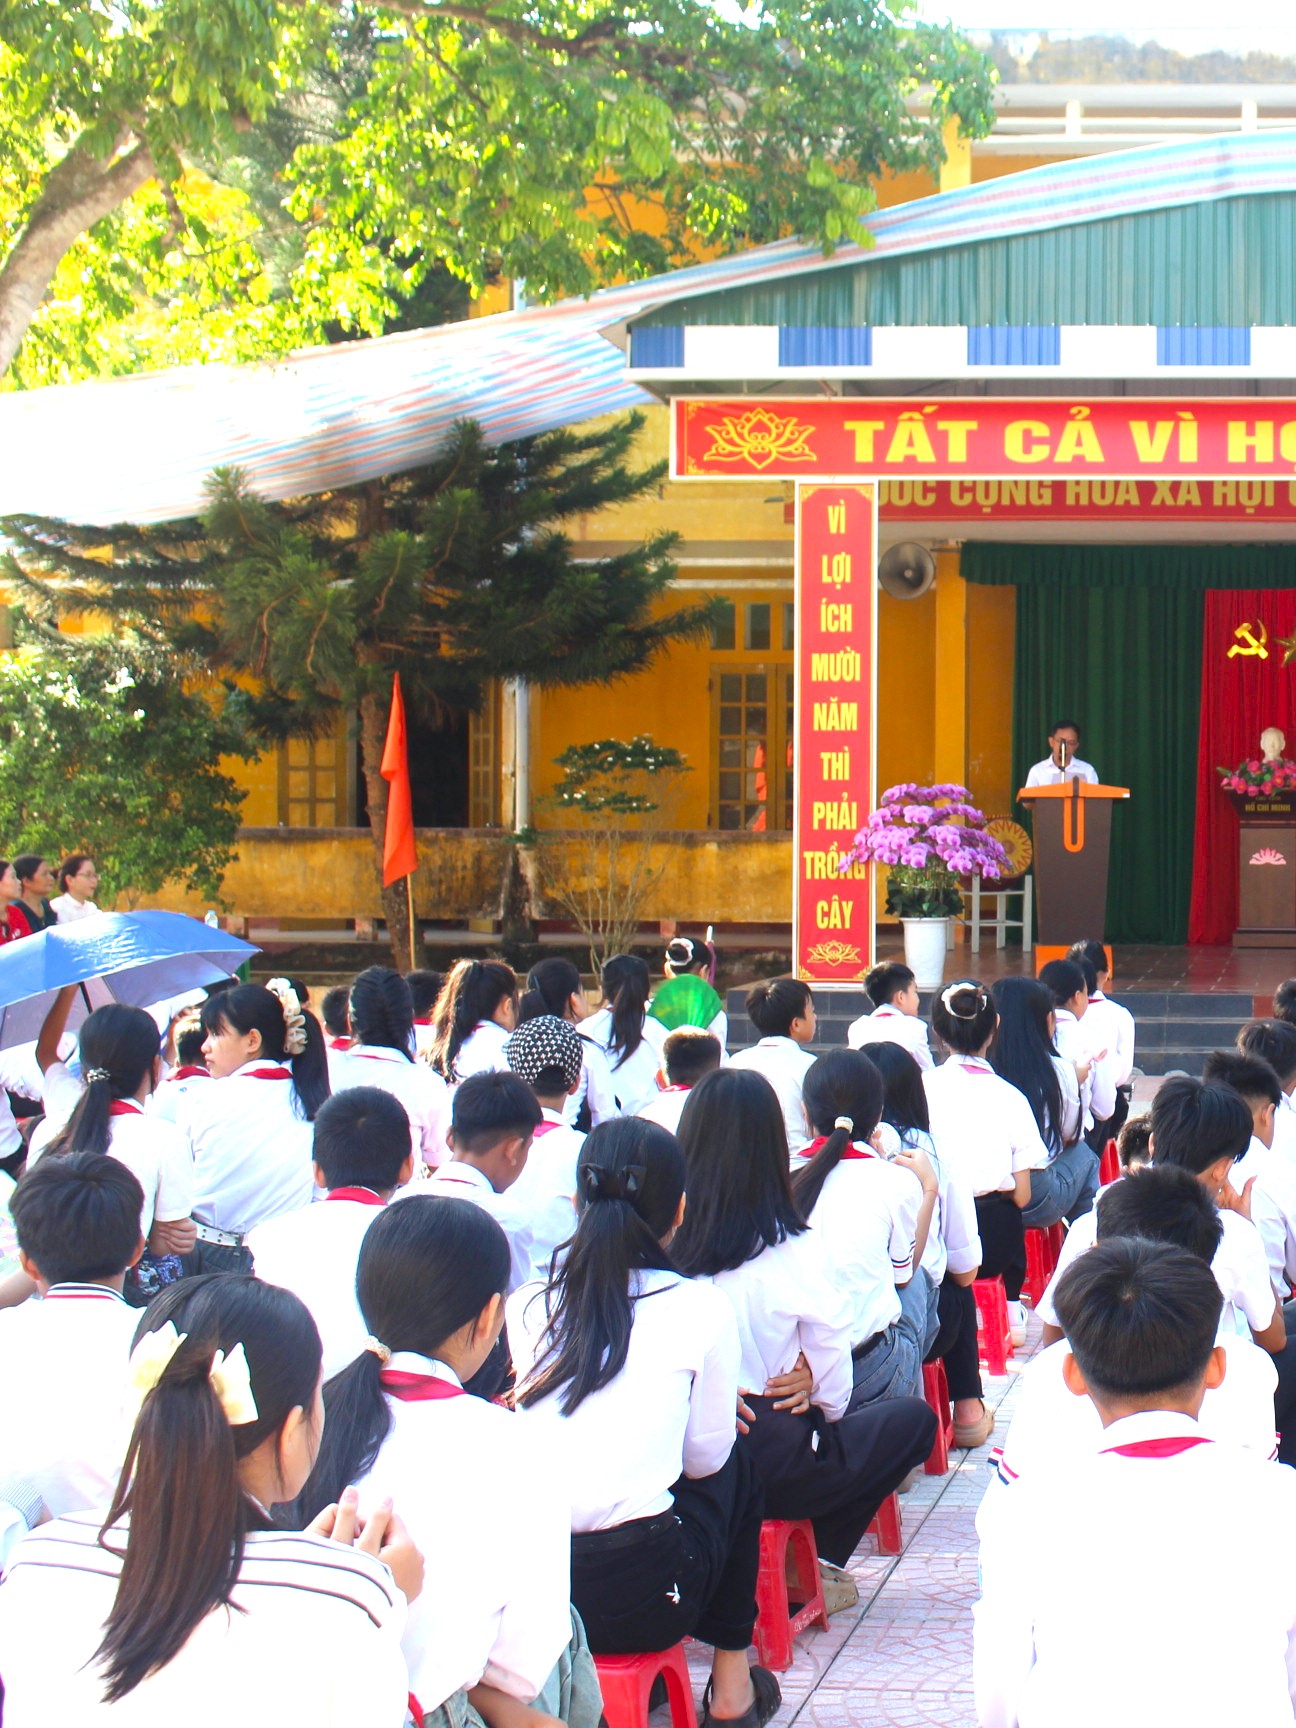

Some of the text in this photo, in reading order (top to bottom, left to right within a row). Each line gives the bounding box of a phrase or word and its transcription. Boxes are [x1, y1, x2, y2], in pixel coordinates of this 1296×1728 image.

[845, 405, 978, 463] TẤT
[1004, 406, 1104, 463] CẢ
[1129, 411, 1198, 463] VÌ
[828, 499, 846, 534] VÌ
[822, 552, 852, 590] LỢI
[821, 598, 853, 633] ÍCH
[811, 646, 861, 682] MƯỜI
[813, 697, 858, 731] NĂM
[820, 746, 850, 780] THÌ
[813, 792, 857, 830] PHẢI
[816, 895, 854, 929] CÂY
